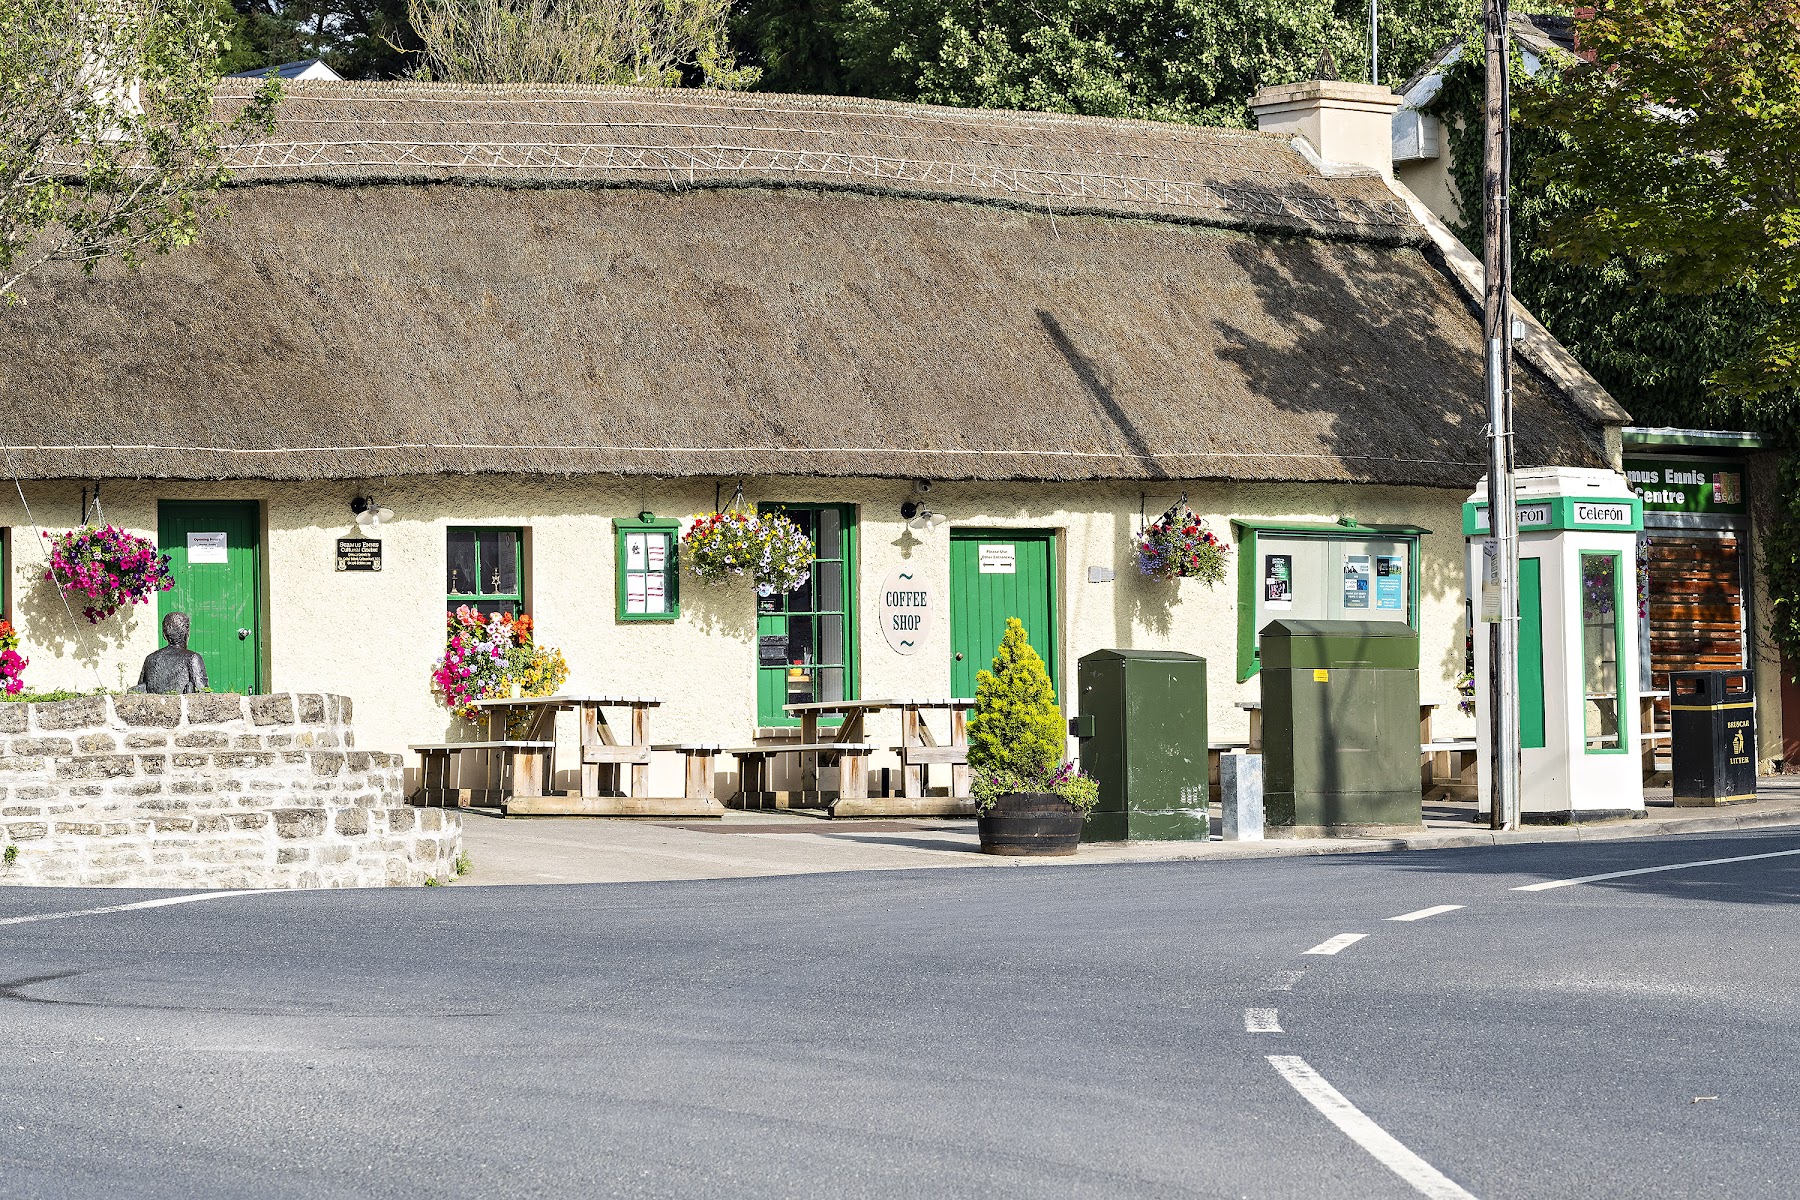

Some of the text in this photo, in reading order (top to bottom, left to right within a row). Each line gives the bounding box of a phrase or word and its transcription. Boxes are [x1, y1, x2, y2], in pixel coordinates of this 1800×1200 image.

[1626, 470, 1659, 484] mus
[1664, 468, 1706, 485] Ennis
[886, 591, 927, 607] COFFEE
[892, 614, 921, 631] SHOP
[1730, 756, 1750, 765] LITTER
